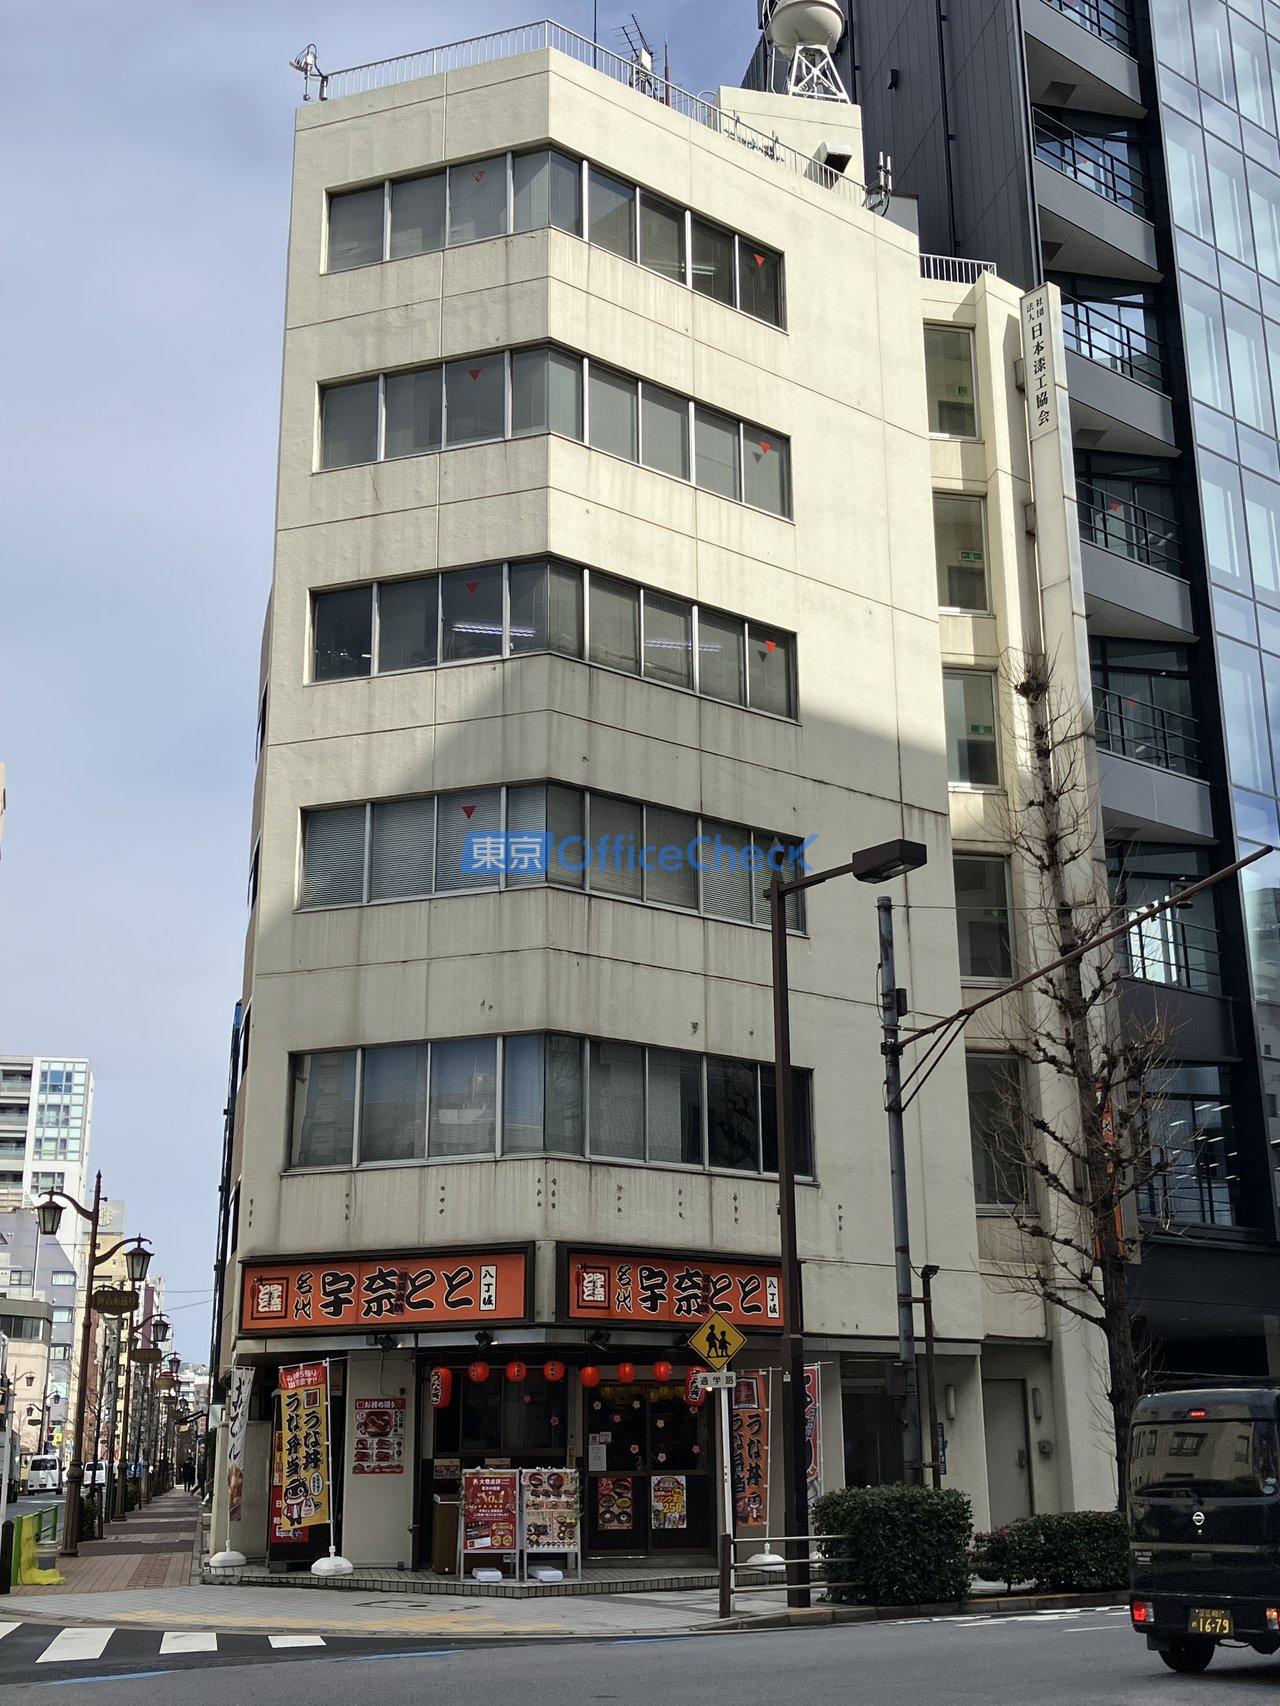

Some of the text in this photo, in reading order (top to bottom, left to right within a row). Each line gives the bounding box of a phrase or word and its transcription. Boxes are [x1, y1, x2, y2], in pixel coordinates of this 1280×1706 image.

[1026, 303, 1035, 322] 法人
[1036, 296, 1045, 319] 社団
[1031, 322, 1050, 426] 日本漆工協会
[294, 1271, 315, 1320] 名代
[319, 1265, 475, 1319] 宇奈とと
[615, 1264, 634, 1314] 名代
[637, 1265, 764, 1317] 宇奈とと
